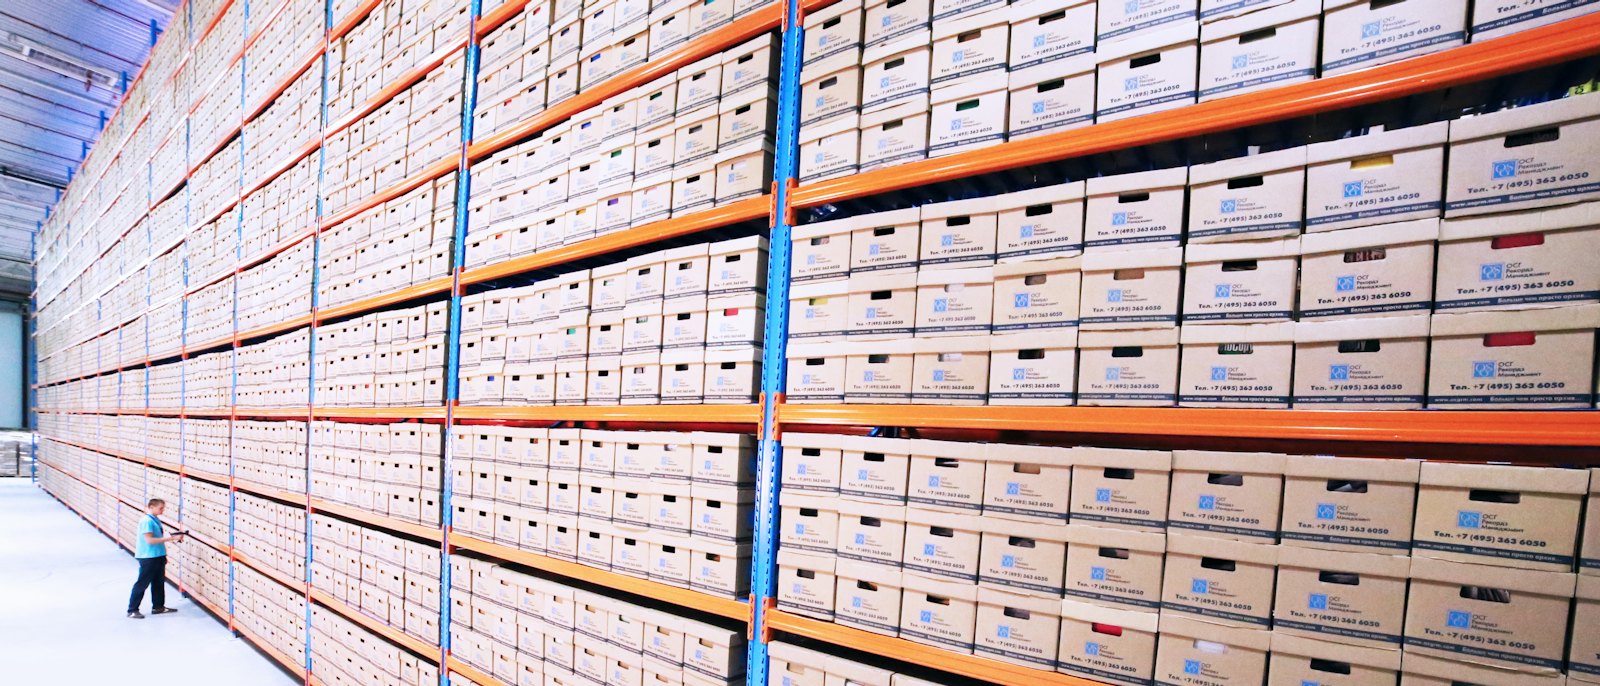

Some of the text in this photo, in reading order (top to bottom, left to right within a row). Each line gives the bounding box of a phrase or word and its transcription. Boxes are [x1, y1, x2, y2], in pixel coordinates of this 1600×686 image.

[1373, 35, 1395, 47] (495)
[1397, 31, 1414, 40] 363
[1417, 24, 1441, 35] 6050
[1261, 65, 1275, 73] 363
[1276, 61, 1296, 70] 6050
[1492, 183, 1503, 191] +7
[1506, 179, 1533, 190] (495)
[1536, 176, 1556, 185] 363
[1559, 171, 1589, 181] 6050
[1356, 198, 1377, 208] (495)
[1397, 192, 1420, 201] 6050
[1495, 283, 1521, 293] (495)
[1546, 280, 1574, 288] 6050
[1348, 294, 1369, 303] (495)
[1487, 382, 1513, 391] (495)
[1328, 524, 1348, 532] (495)
[1367, 527, 1389, 535] 6050
[1470, 534, 1495, 543] (495)
[1519, 539, 1547, 548] 6050
[1233, 603, 1252, 611] 6050
[1319, 614, 1340, 623] (495)
[1358, 619, 1380, 628] 6050
[1460, 633, 1485, 644] (495)
[1487, 638, 1506, 646] 363
[1508, 641, 1536, 651] 6050
